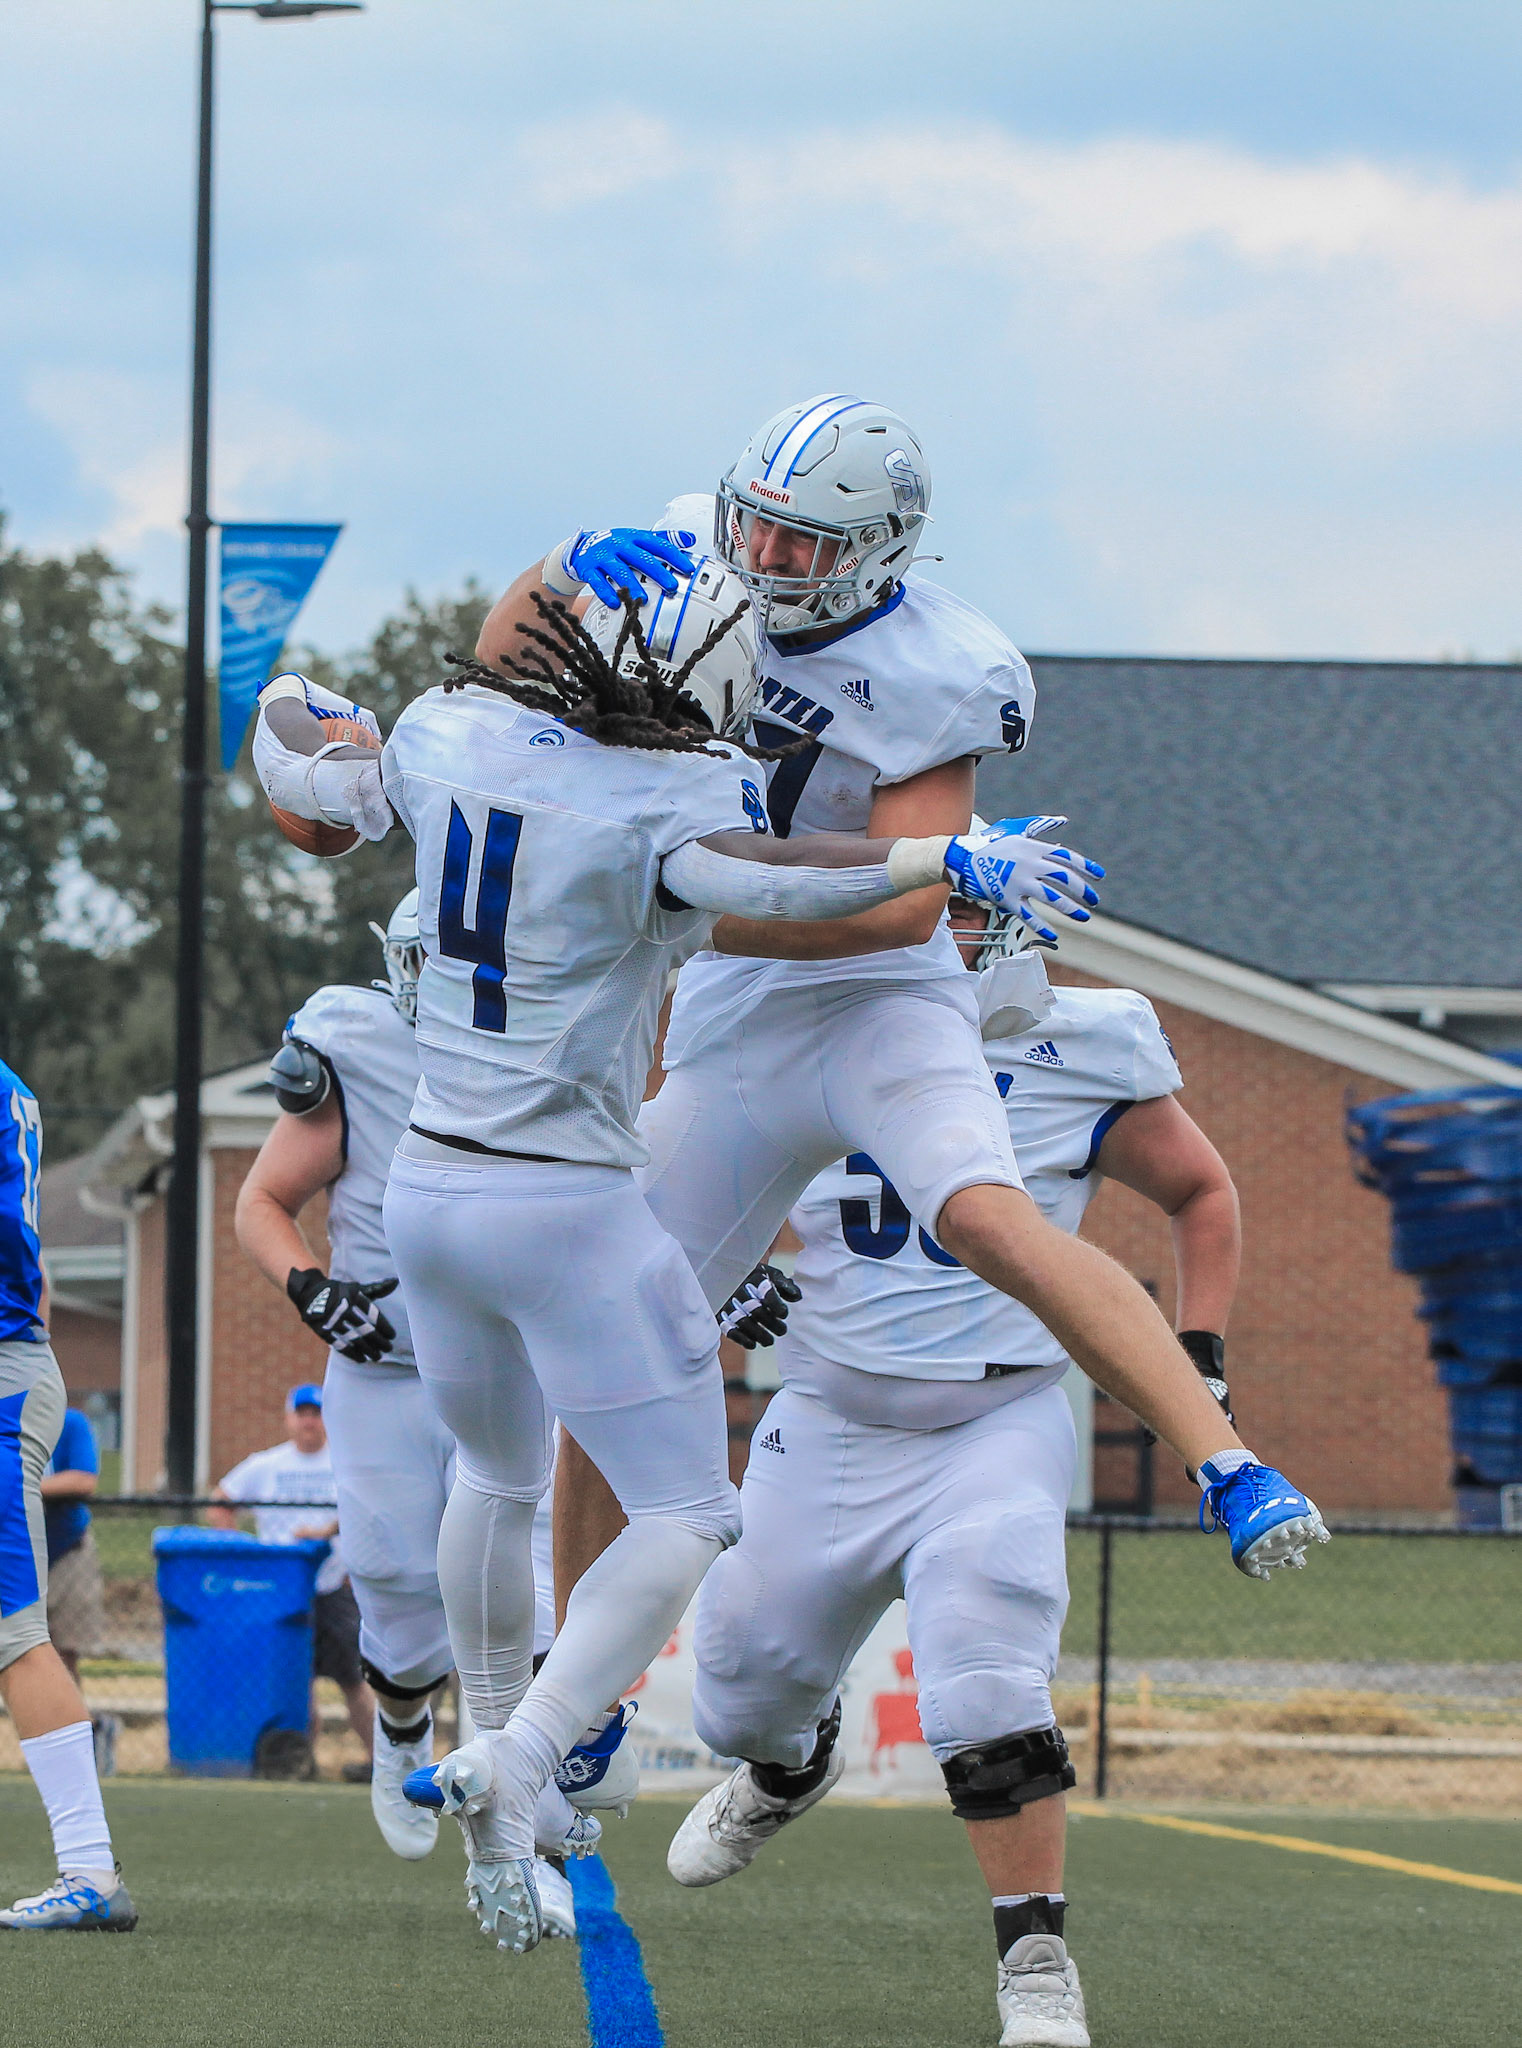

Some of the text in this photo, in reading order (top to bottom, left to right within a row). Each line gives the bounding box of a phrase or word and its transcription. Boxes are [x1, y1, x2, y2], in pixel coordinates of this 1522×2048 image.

[750, 481, 790, 504] Riddell
[840, 684, 875, 712] adidas
[438, 796, 524, 1034] 4
